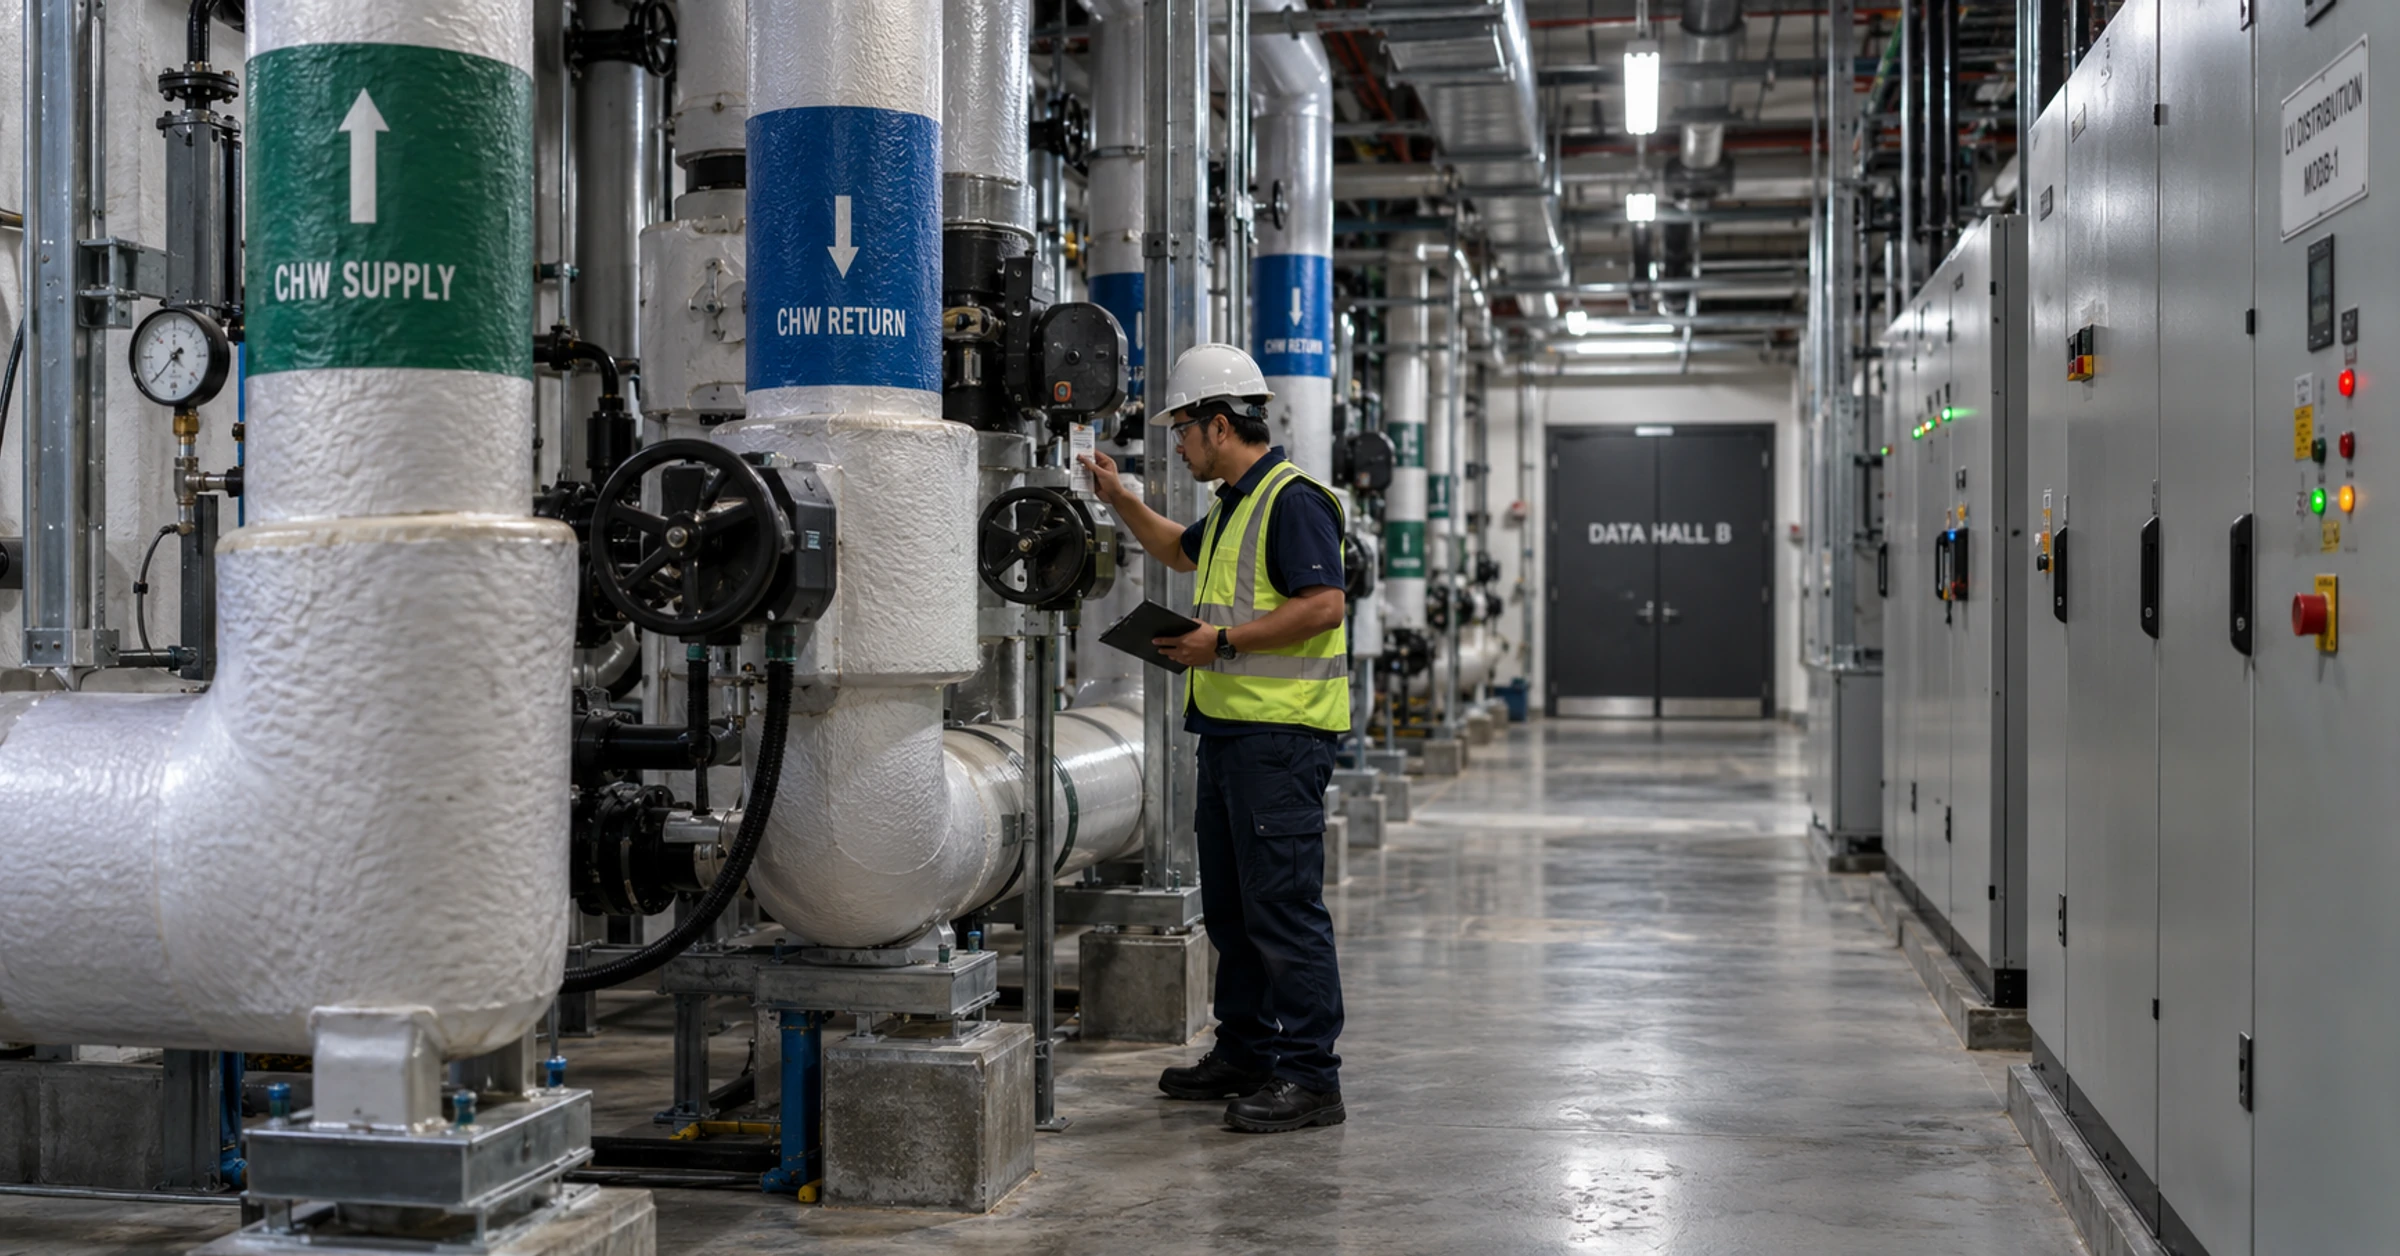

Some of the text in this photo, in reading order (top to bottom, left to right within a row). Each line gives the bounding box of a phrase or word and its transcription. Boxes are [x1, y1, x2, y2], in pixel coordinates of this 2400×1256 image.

[2285, 71, 2362, 155] LV DISTRIBUTION
[275, 261, 456, 302] CHW SUPPLY
[777, 306, 905, 337] CHW RETURN
[1588, 522, 1732, 545] DATA HALL B
